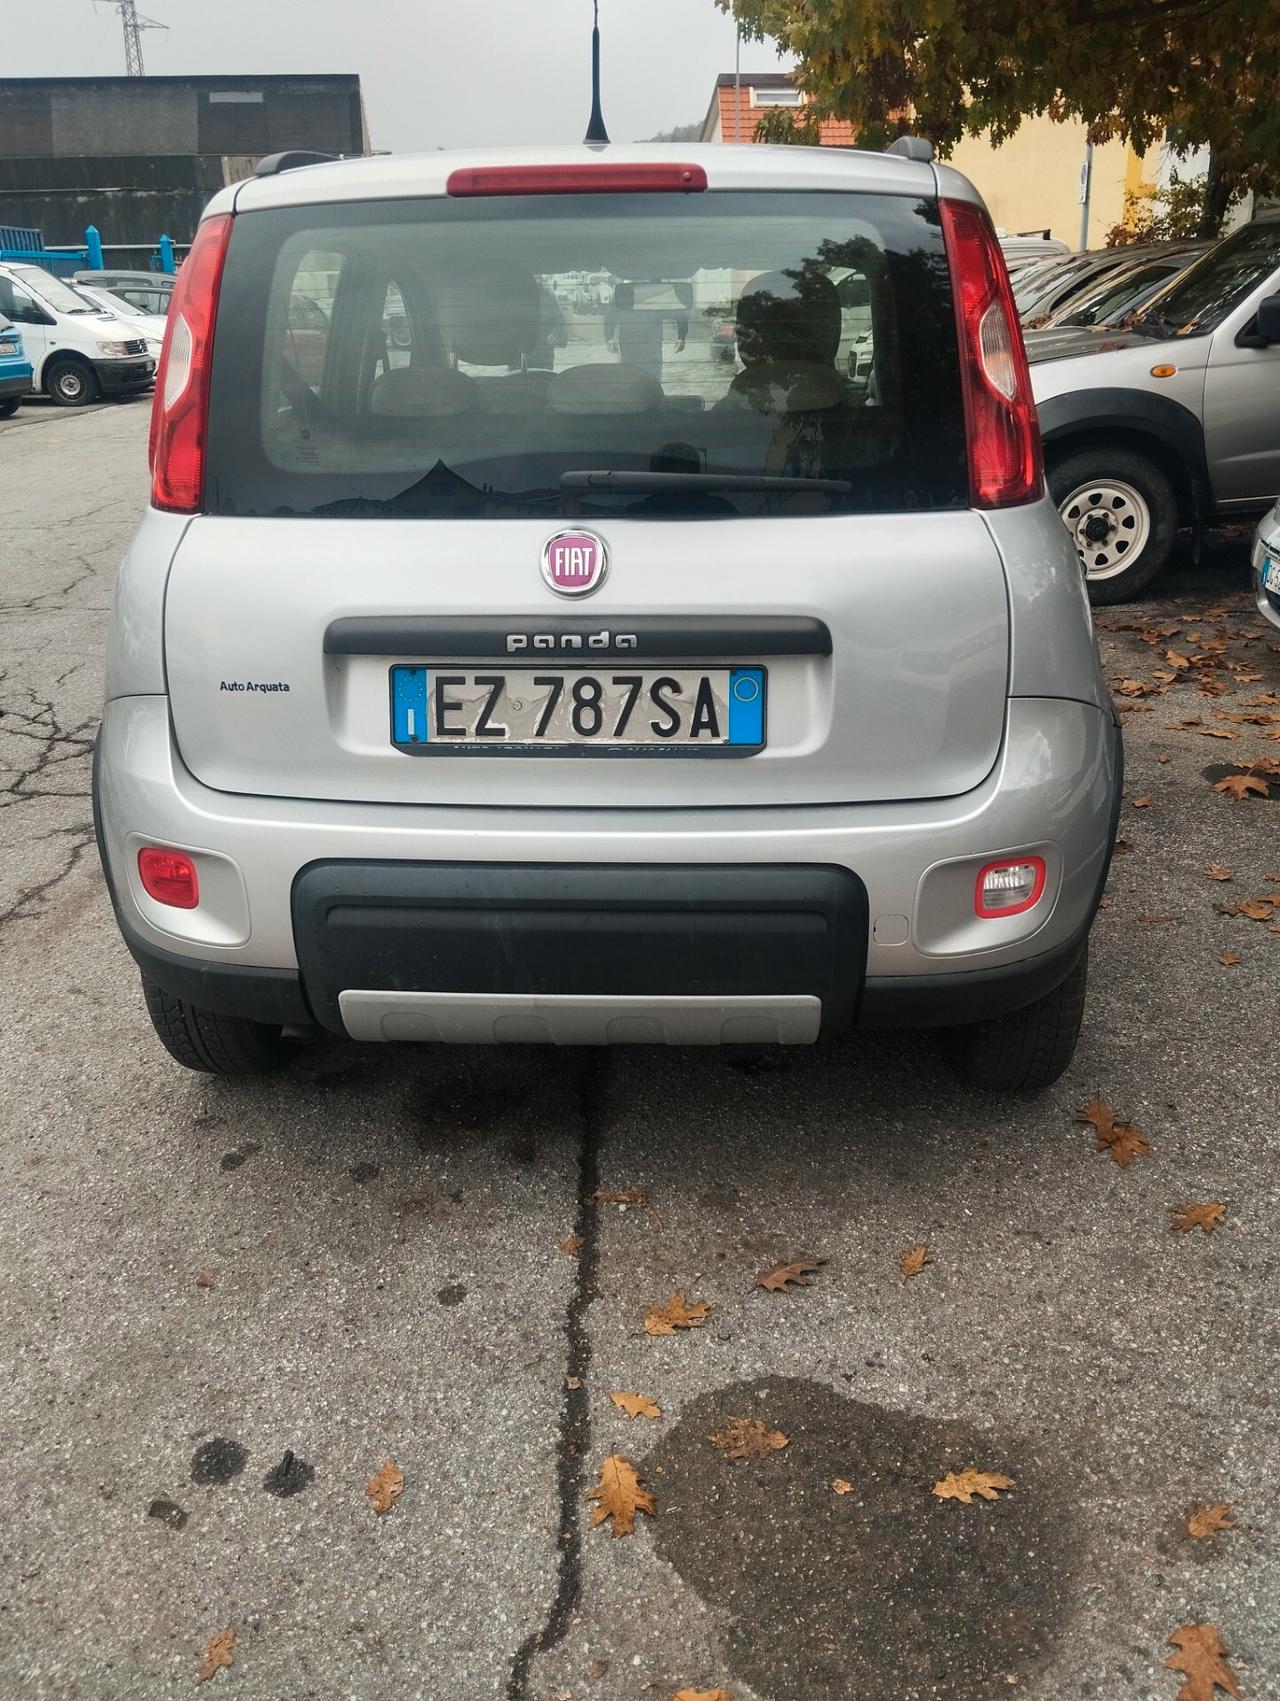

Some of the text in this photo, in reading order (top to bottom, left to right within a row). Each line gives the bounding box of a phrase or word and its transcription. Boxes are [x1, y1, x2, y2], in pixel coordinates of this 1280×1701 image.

[555, 547, 593, 577] FIAT
[506, 631, 638, 653] panda
[219, 681, 290, 694] Auto Arquata
[435, 676, 506, 737] EZ
[533, 676, 720, 738] 787SA
